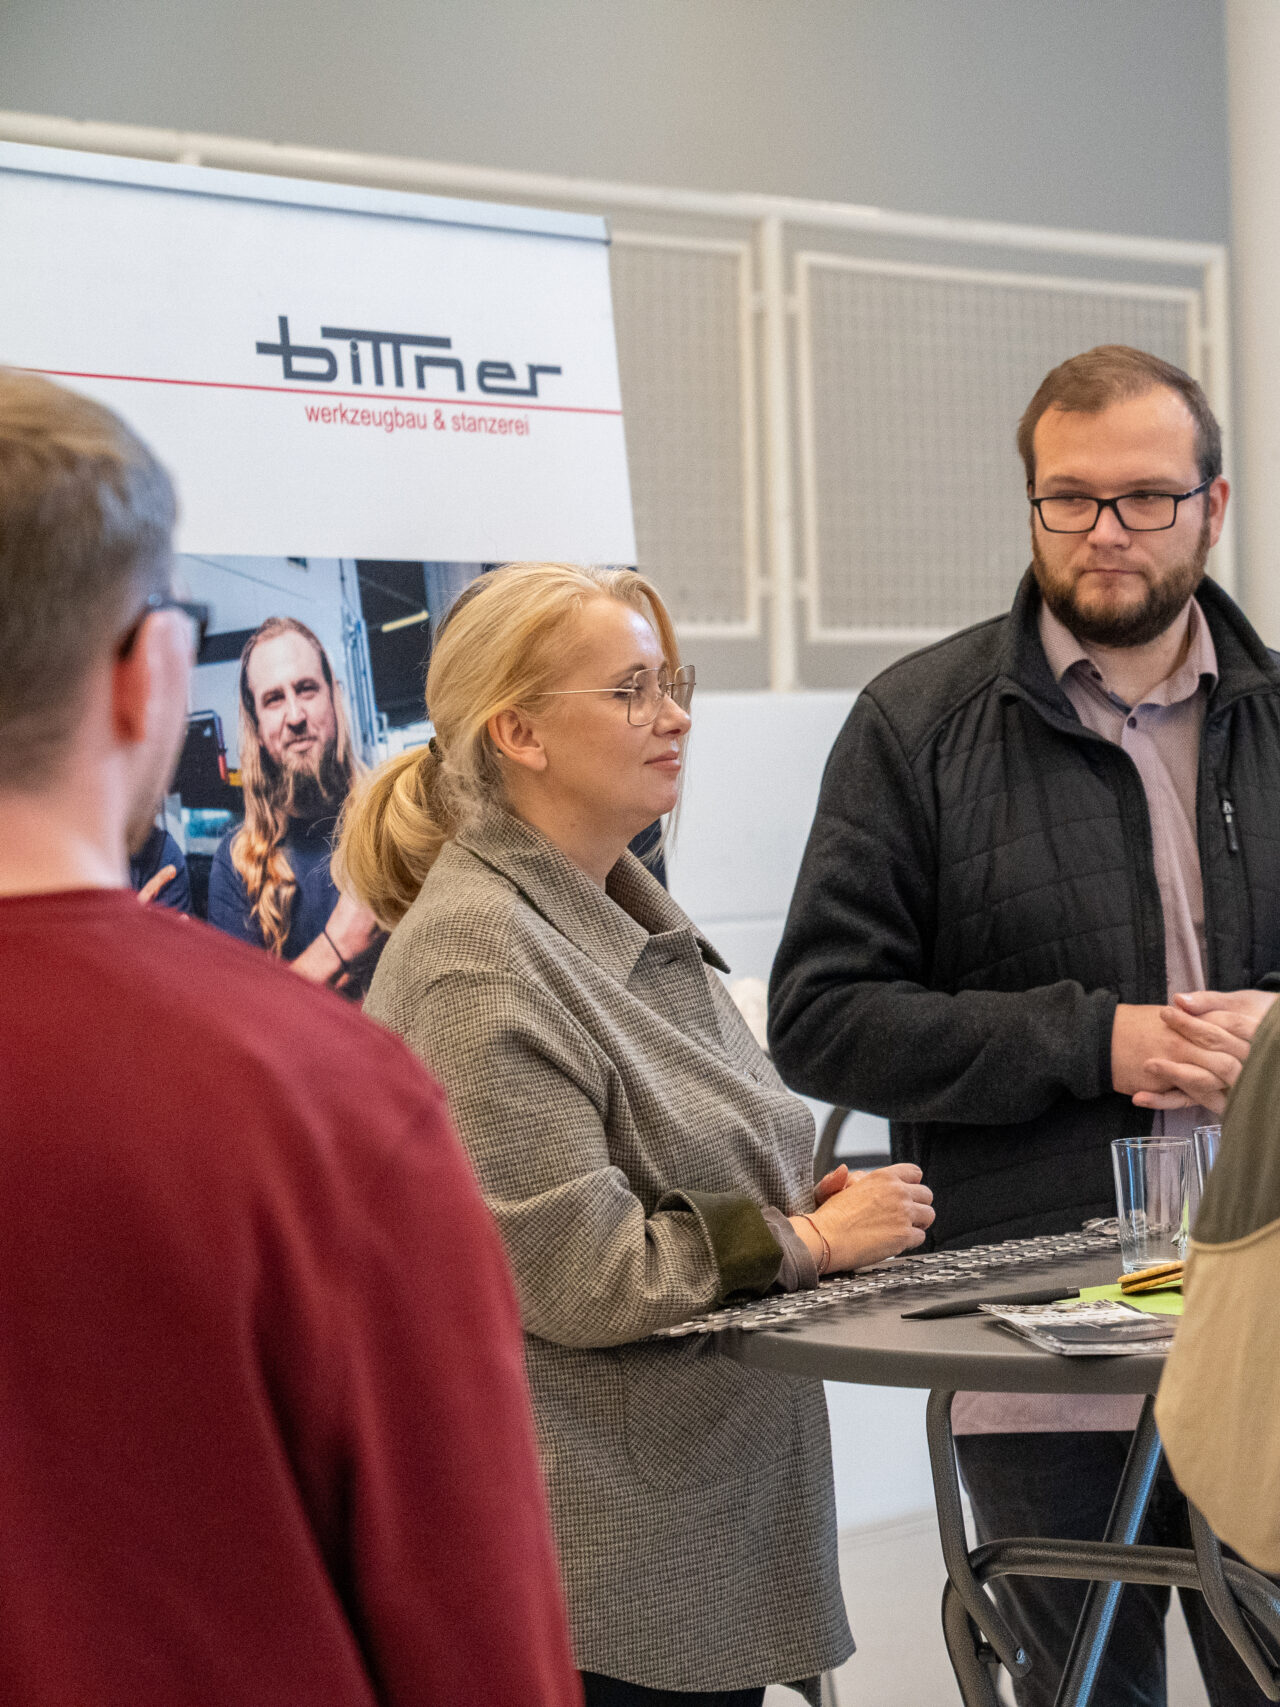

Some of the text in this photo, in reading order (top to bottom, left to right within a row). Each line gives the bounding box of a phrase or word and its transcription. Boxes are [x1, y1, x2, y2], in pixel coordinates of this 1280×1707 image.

[304, 402, 530, 436] werkzeugbau & stanzerei
